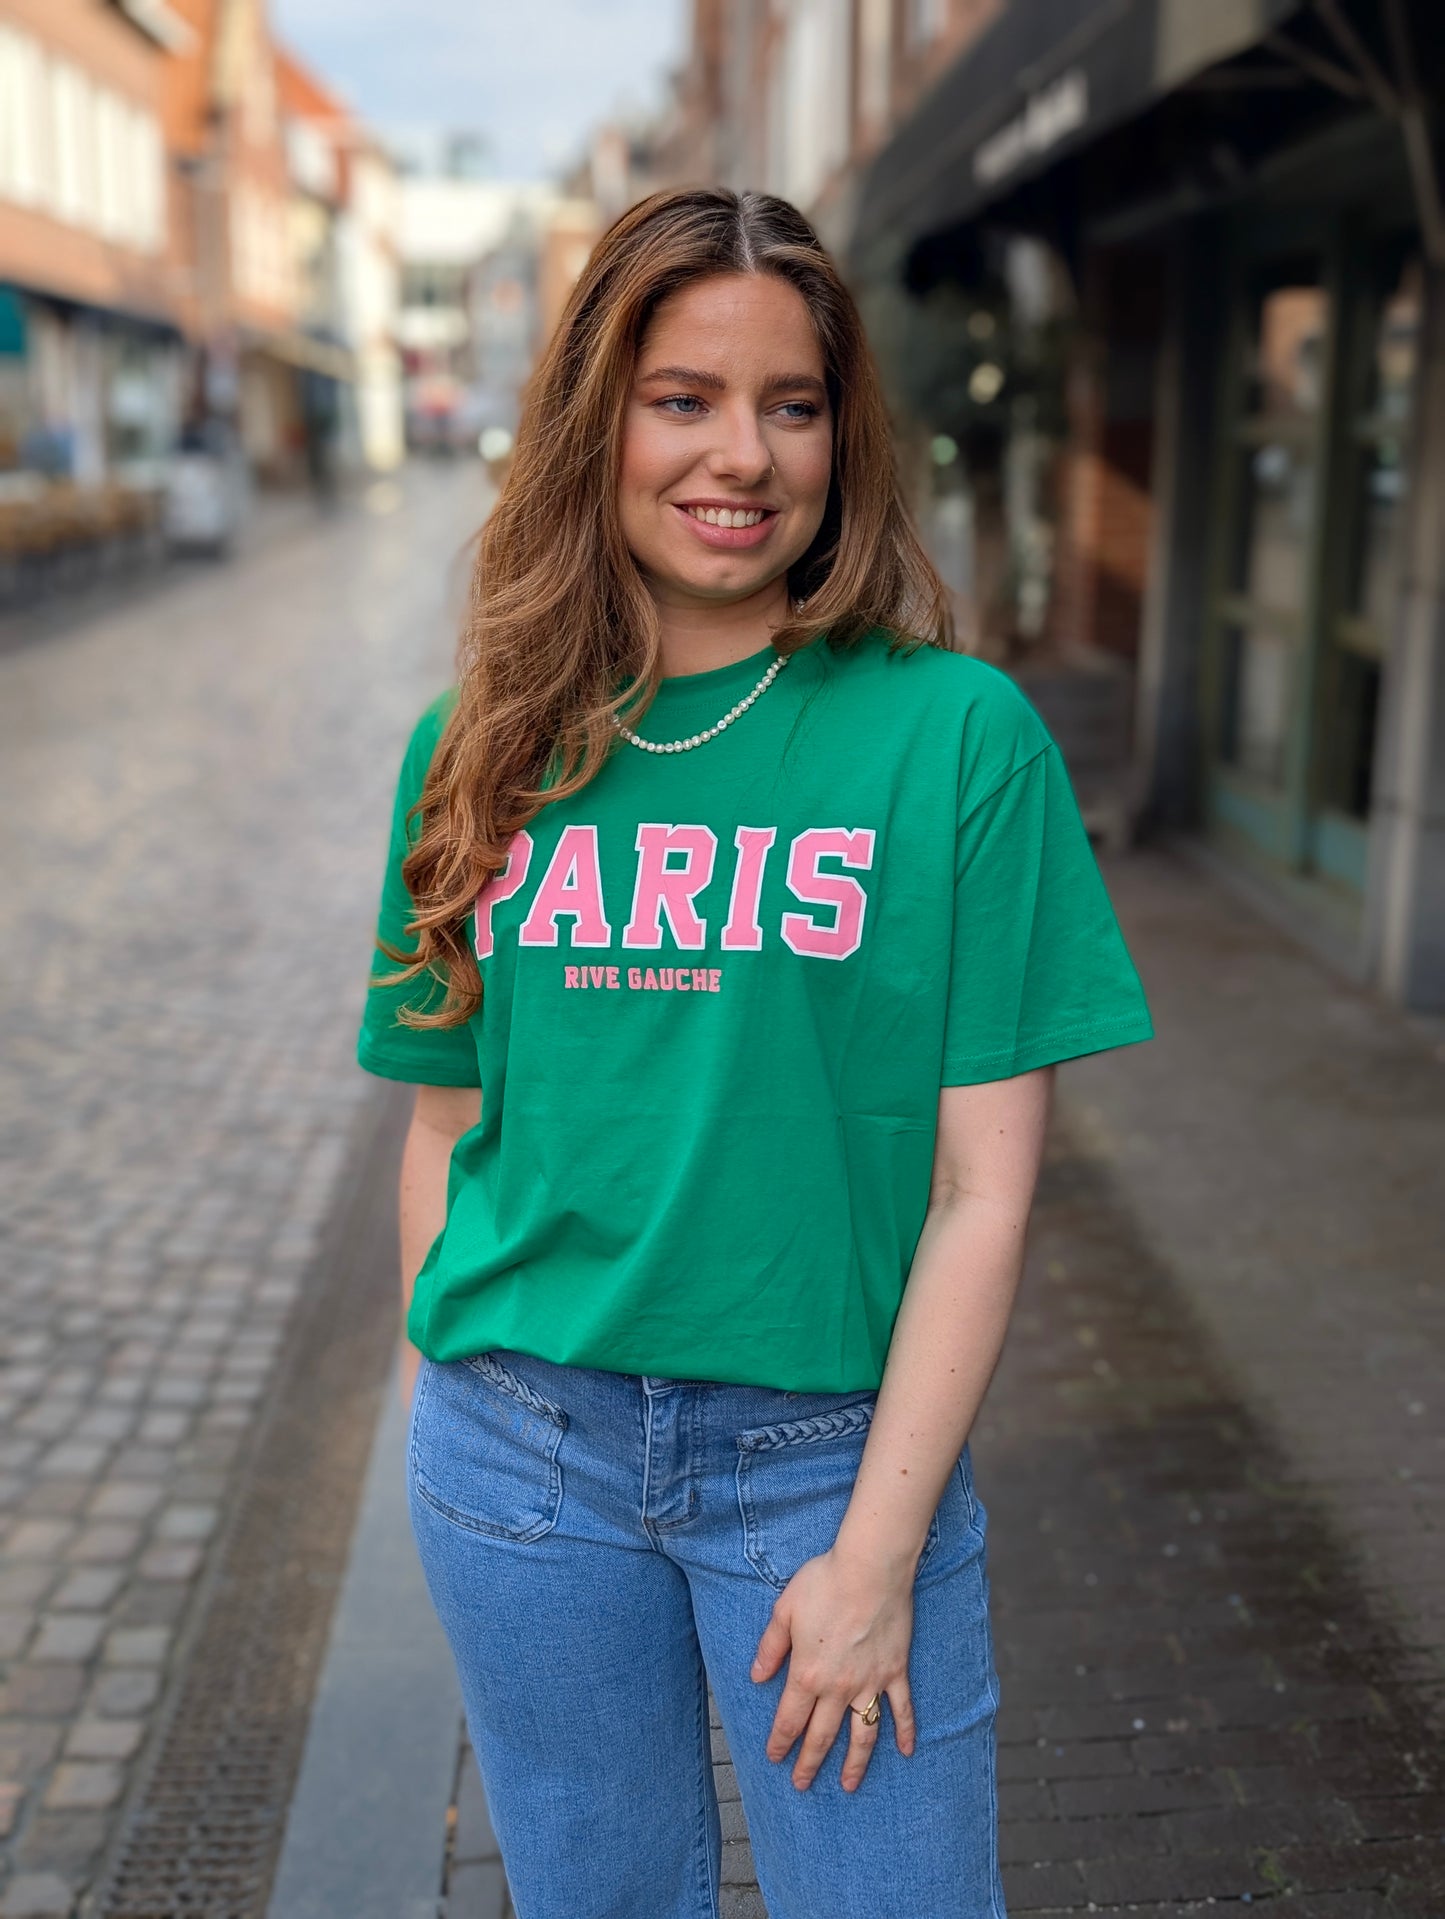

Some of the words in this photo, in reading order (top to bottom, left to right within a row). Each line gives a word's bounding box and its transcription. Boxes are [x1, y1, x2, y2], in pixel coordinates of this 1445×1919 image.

[474, 823, 876, 961] PARIS
[564, 966, 620, 989] RIVE
[628, 967, 722, 992] GAUCHE
